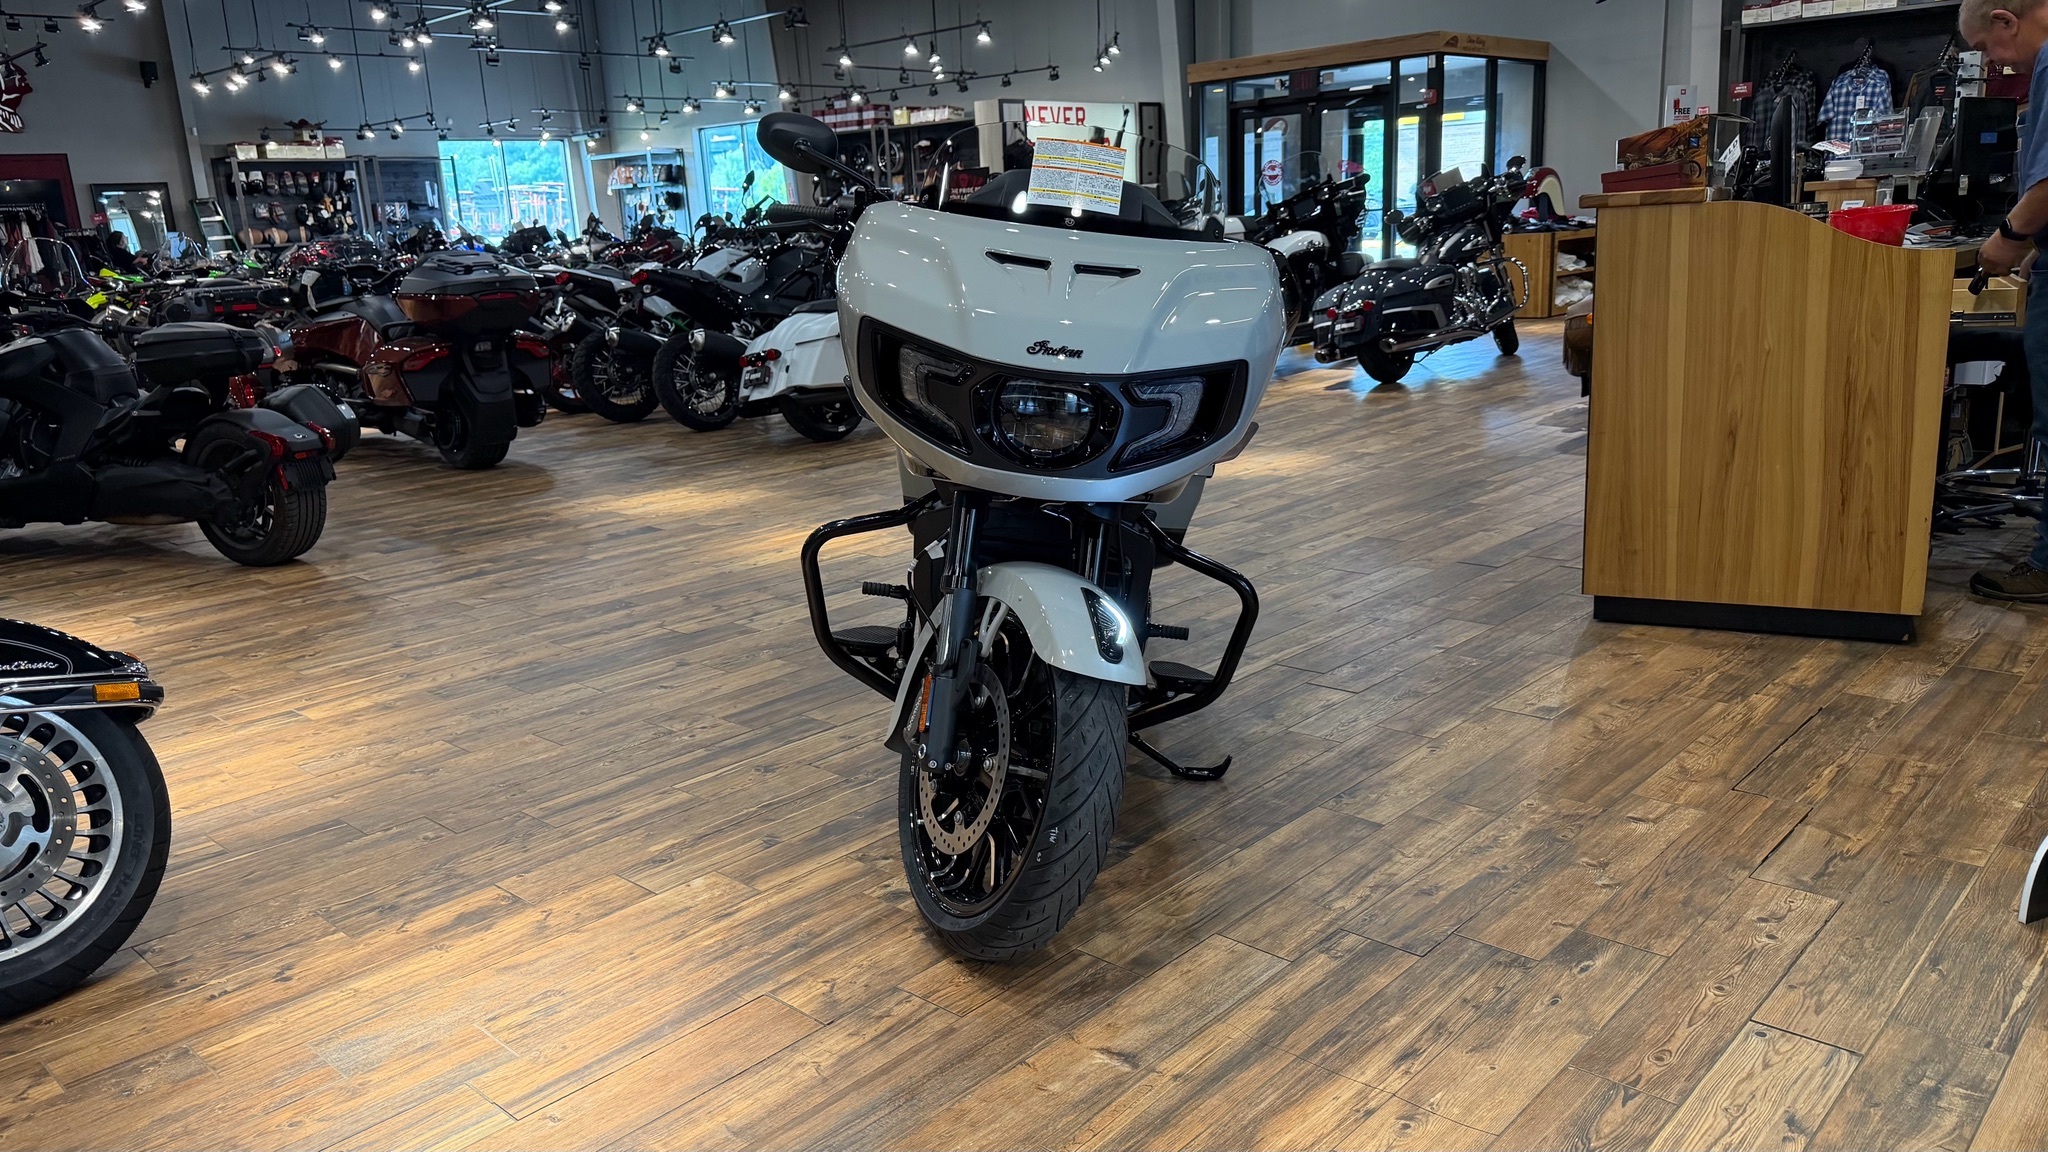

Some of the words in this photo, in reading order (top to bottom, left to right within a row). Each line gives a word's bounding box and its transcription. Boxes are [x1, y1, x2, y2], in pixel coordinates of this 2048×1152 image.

[1024, 105, 1086, 126] NEVER
[1673, 107, 1691, 115] FREE
[1026, 340, 1084, 359] Indian
